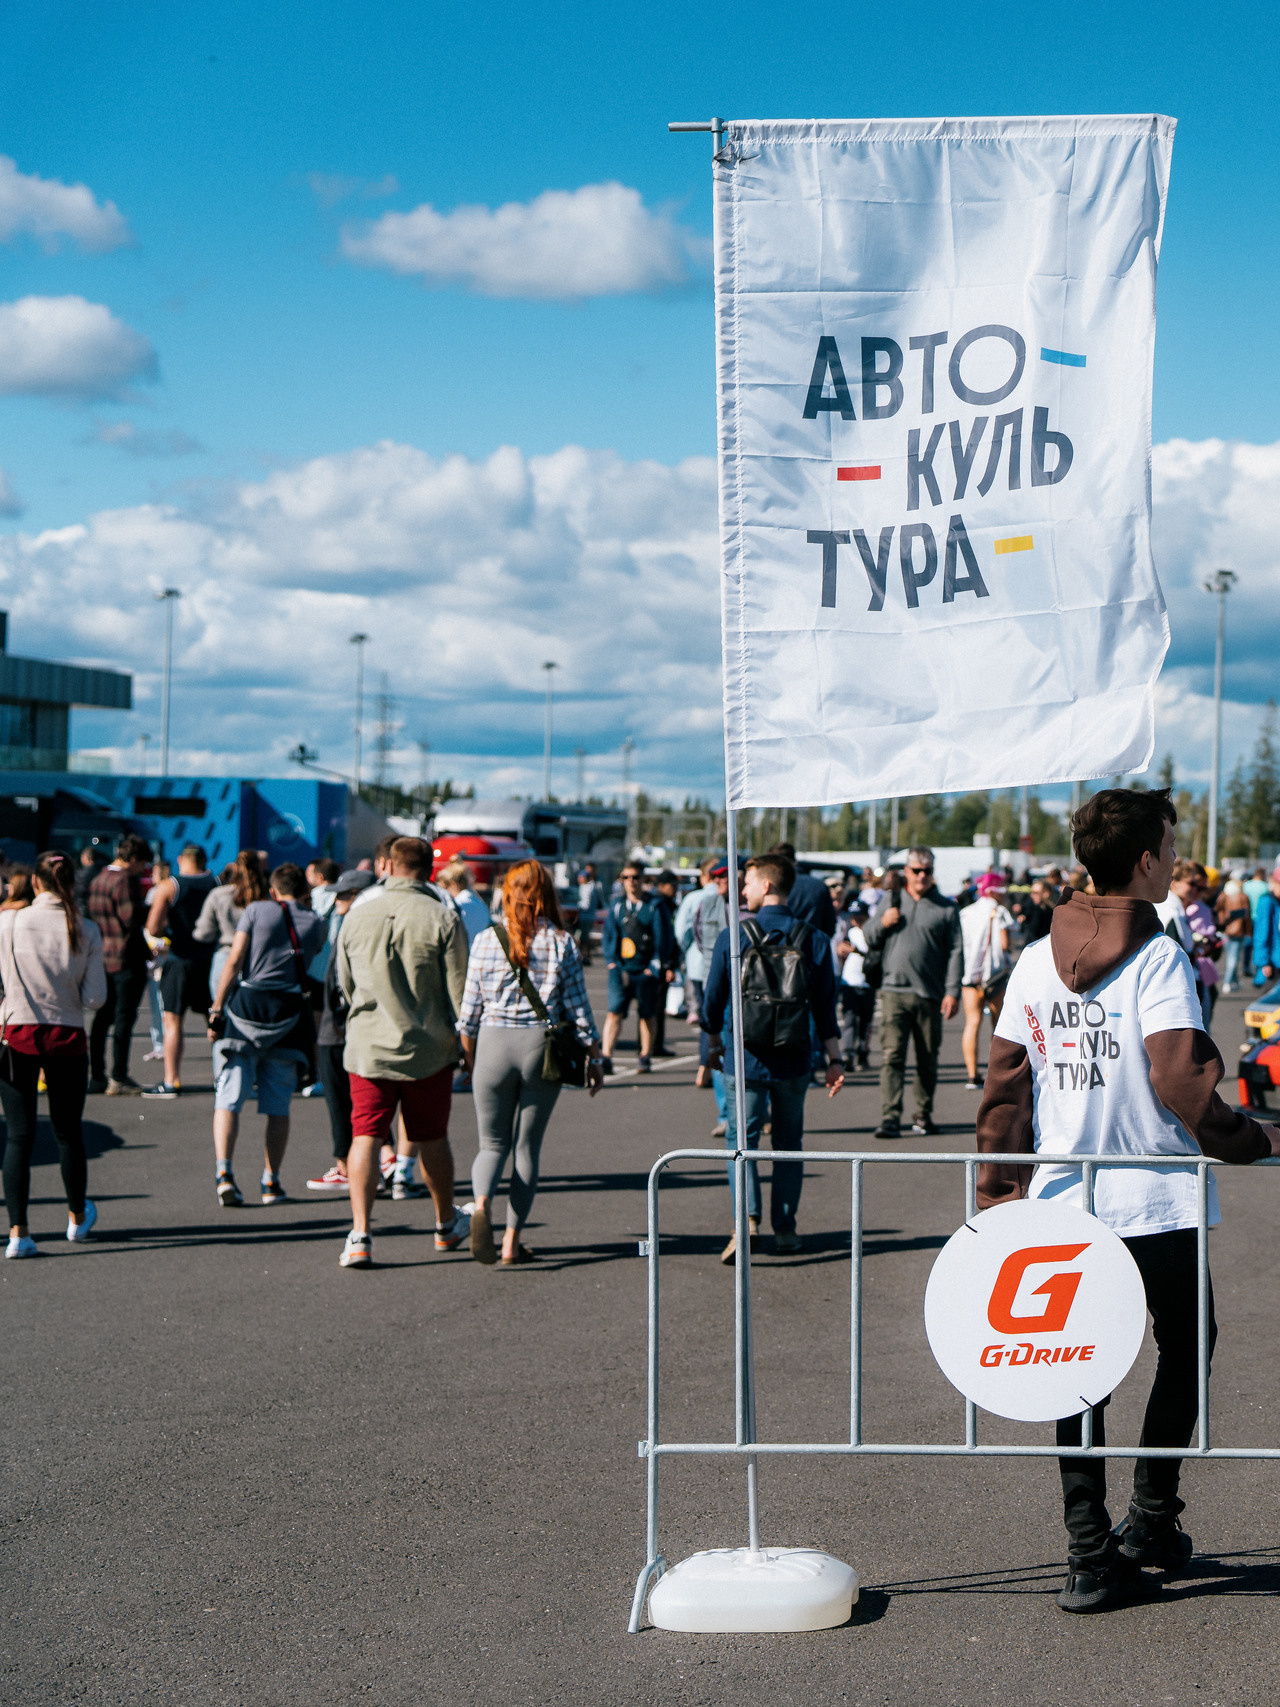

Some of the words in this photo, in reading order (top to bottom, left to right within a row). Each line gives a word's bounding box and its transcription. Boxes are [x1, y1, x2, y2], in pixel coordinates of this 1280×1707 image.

[802, 324, 1027, 421] АВТО
[906, 406, 1074, 511] КУЛЬ
[806, 514, 990, 612] ТУРА
[1053, 1062, 1105, 1090] ТУРА
